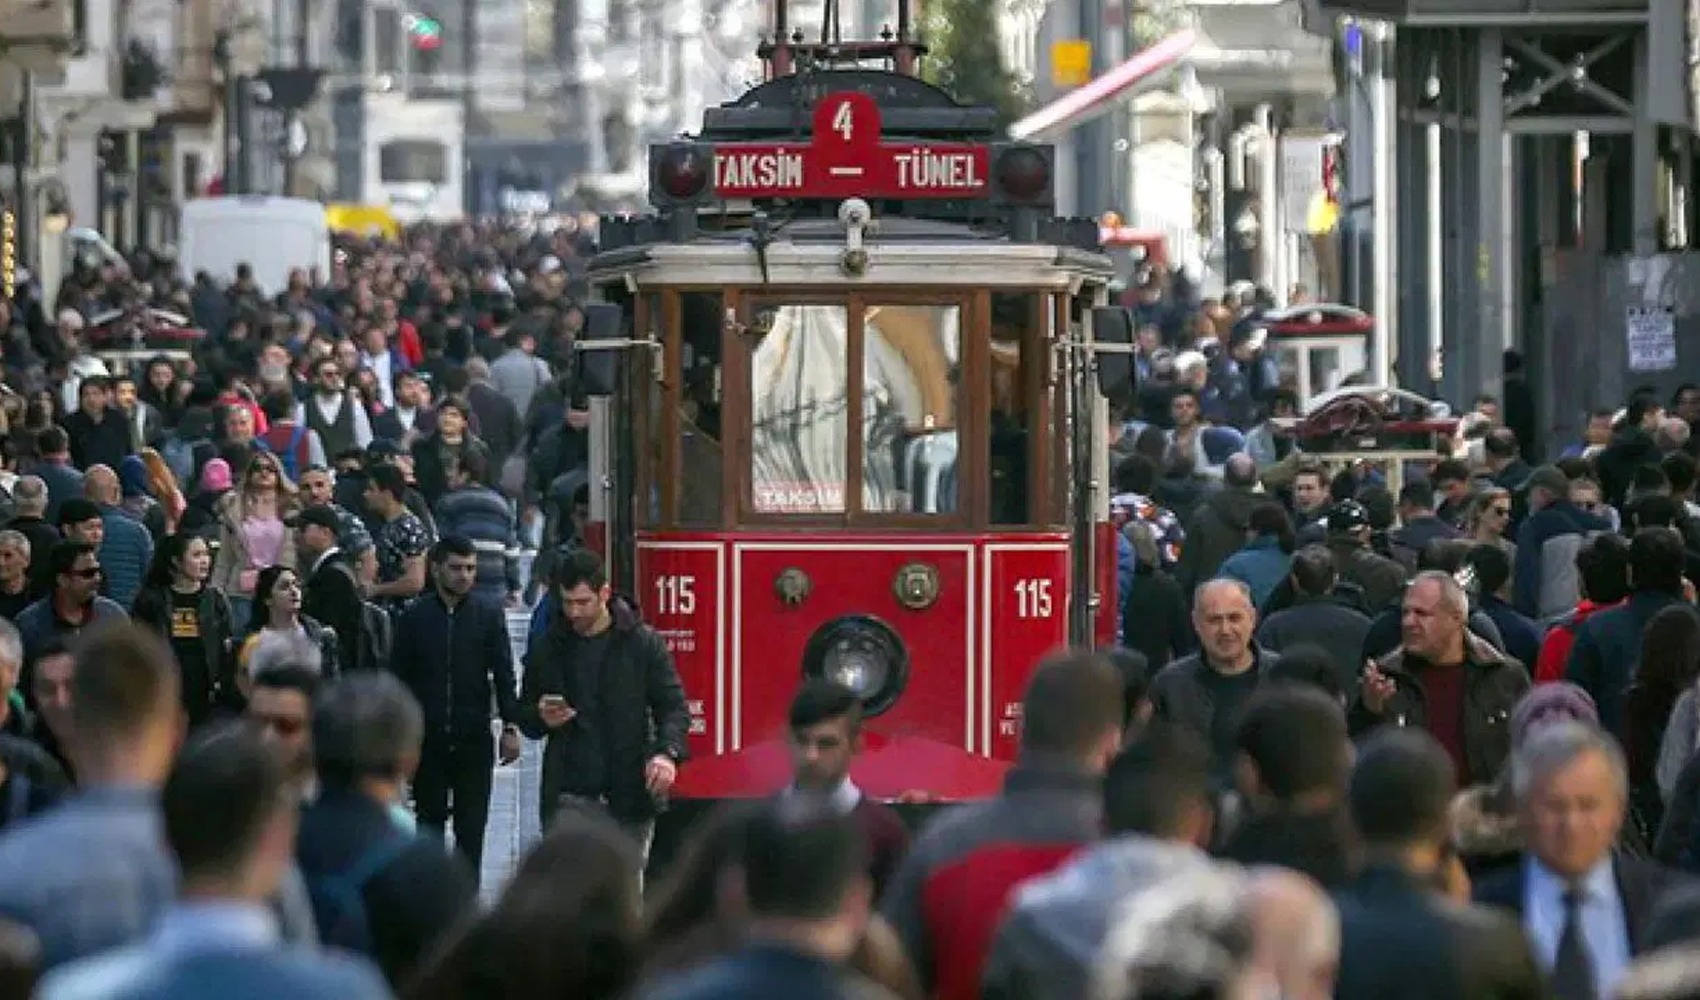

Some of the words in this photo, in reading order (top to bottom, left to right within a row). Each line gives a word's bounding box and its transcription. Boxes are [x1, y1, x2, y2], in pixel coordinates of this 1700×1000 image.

[832, 100, 853, 140] 4
[893, 148, 984, 188] TÜNEL
[656, 575, 696, 614] 115
[1014, 579, 1052, 617] 115
